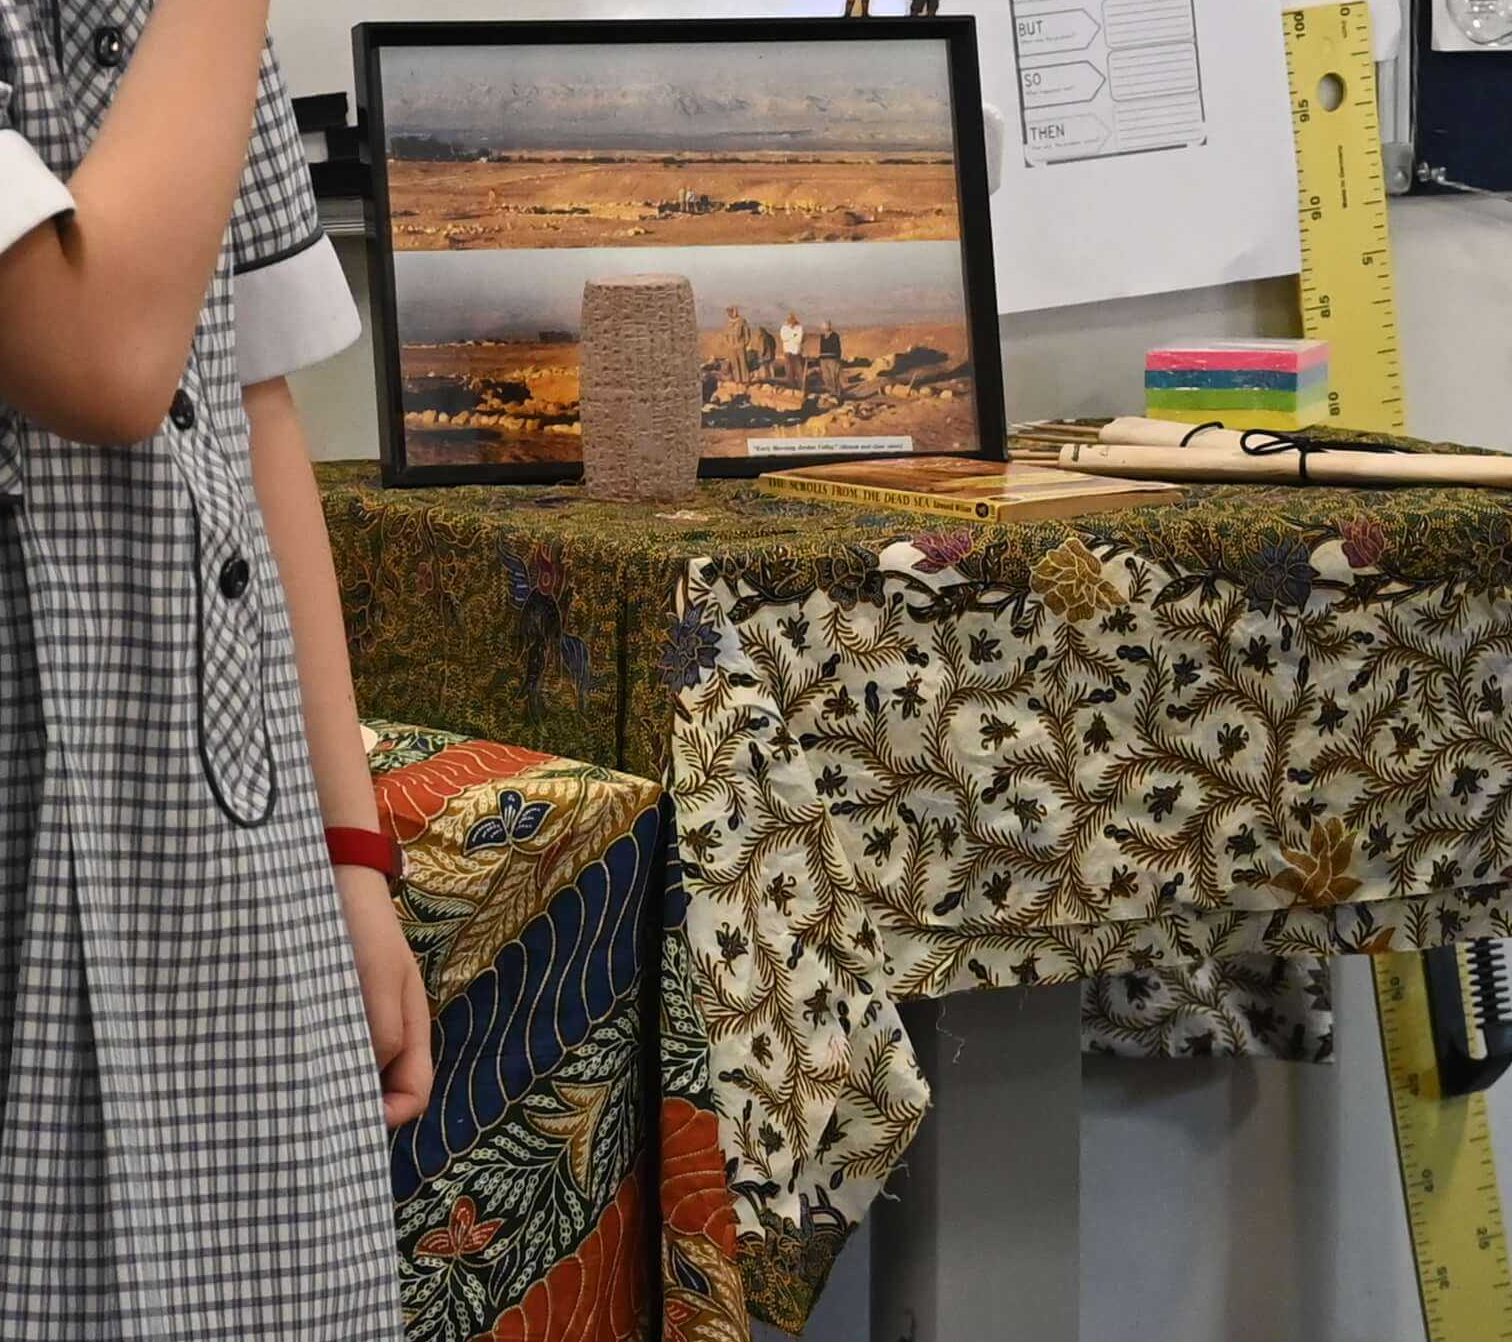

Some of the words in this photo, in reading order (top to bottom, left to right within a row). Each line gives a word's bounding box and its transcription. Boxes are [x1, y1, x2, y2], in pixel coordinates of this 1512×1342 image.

[1018, 19, 1043, 37] BUT
[1294, 10, 1306, 41] 100
[1024, 73, 1042, 87] SO
[1030, 124, 1066, 142] THEN
[1362, 255, 1374, 266] 5
[768, 477, 785, 490] THE
[790, 479, 828, 496] SCROLLS
[831, 484, 859, 500] FROM
[863, 489, 881, 503] THE
[884, 491, 910, 506] DEAD
[914, 495, 930, 508] SEA
